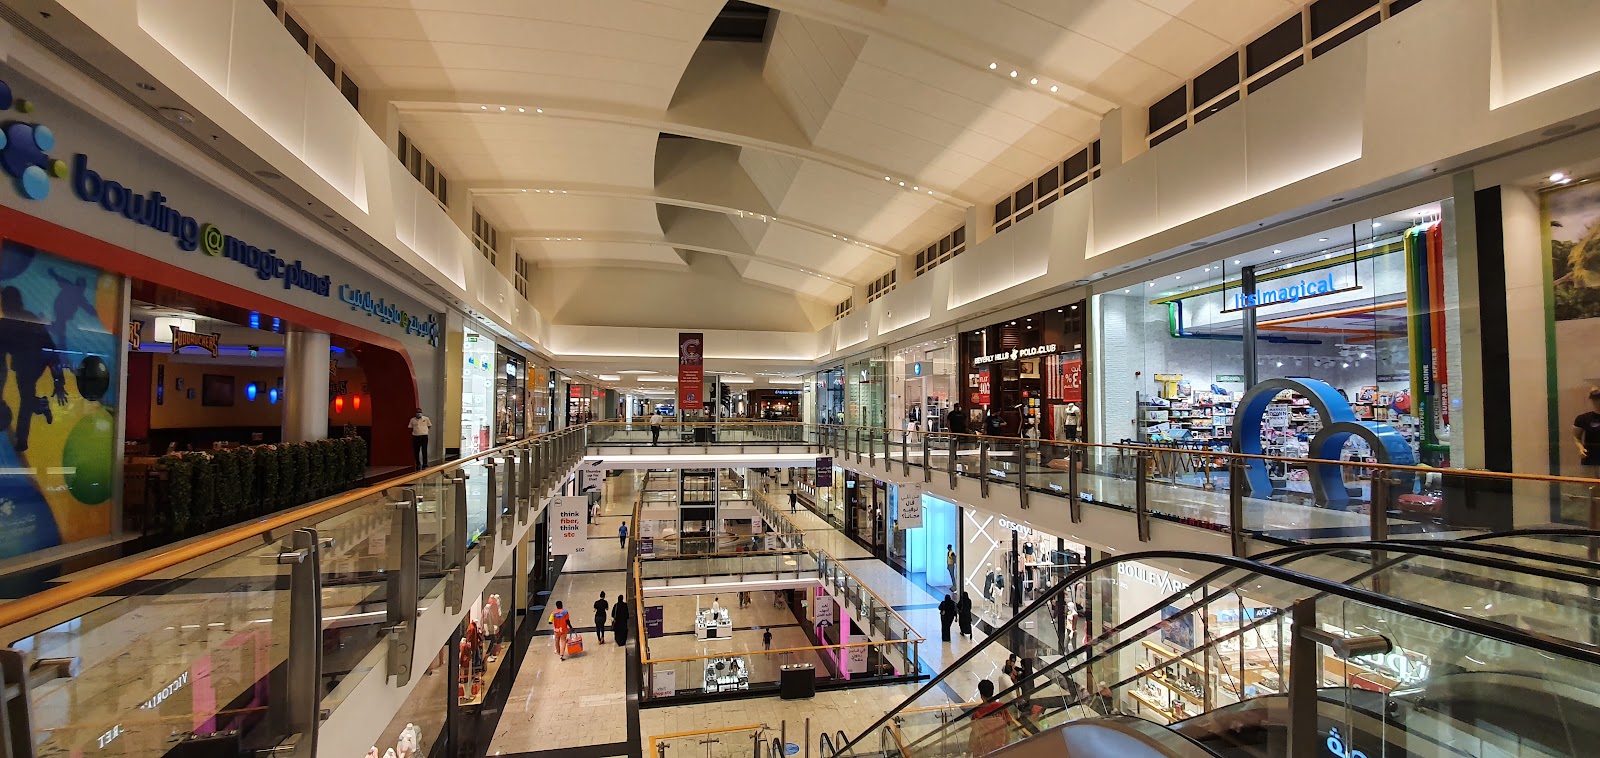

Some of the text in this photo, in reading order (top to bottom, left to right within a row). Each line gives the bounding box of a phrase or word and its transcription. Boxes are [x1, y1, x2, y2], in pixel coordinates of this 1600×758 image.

[75, 153, 331, 297] bowling @ magic planet
[974, 355, 994, 364] BEVERLY
[994, 352, 1009, 361] HILLS
[1020, 348, 1036, 357] POLO
[999, 518, 1030, 539] orsay
